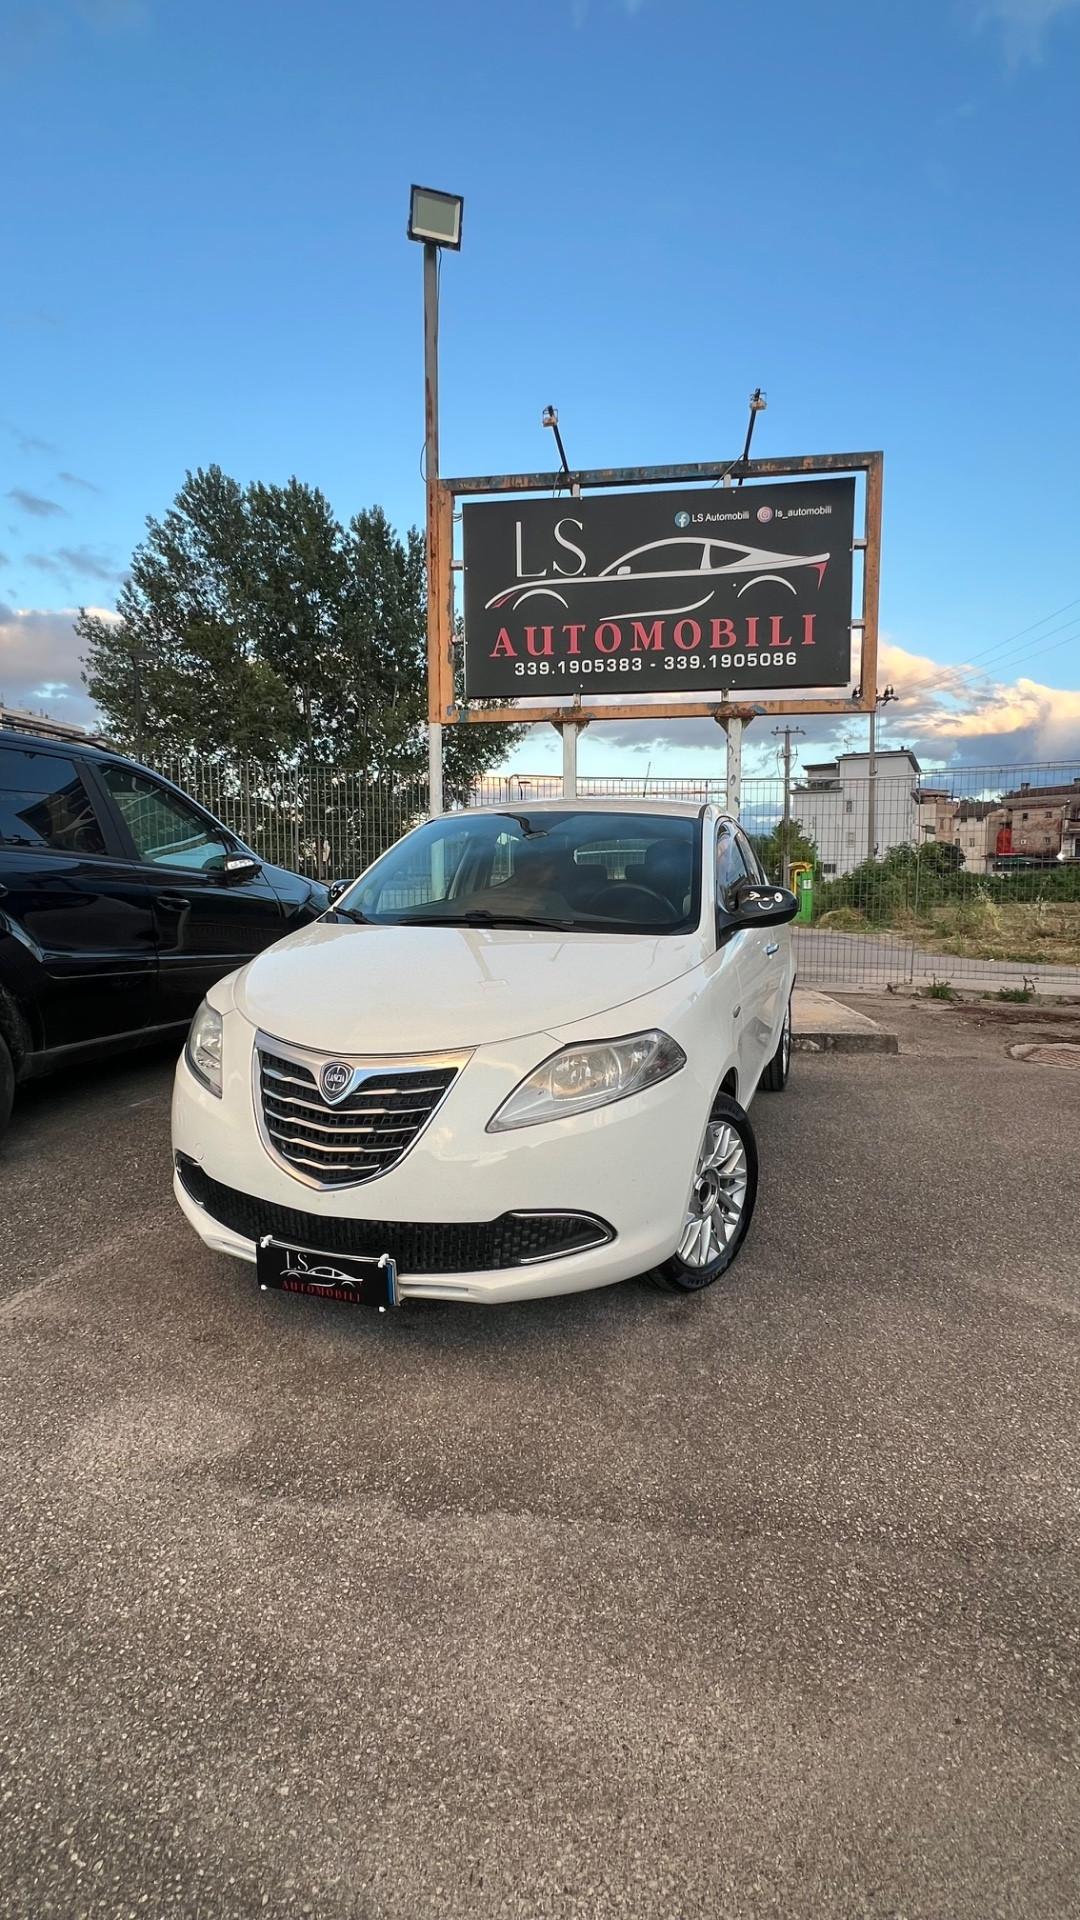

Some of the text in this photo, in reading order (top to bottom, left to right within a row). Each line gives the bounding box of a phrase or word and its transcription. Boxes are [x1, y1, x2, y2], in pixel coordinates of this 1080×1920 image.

[692, 511, 749, 522] LS Automobili
[775, 506, 832, 519] ls_automobili
[489, 614, 817, 658] AUTOMOBILI
[514, 657, 643, 677] 339.1905383
[663, 651, 798, 671] 339.1905086
[281, 1279, 361, 1303] AUTOMOBILI
